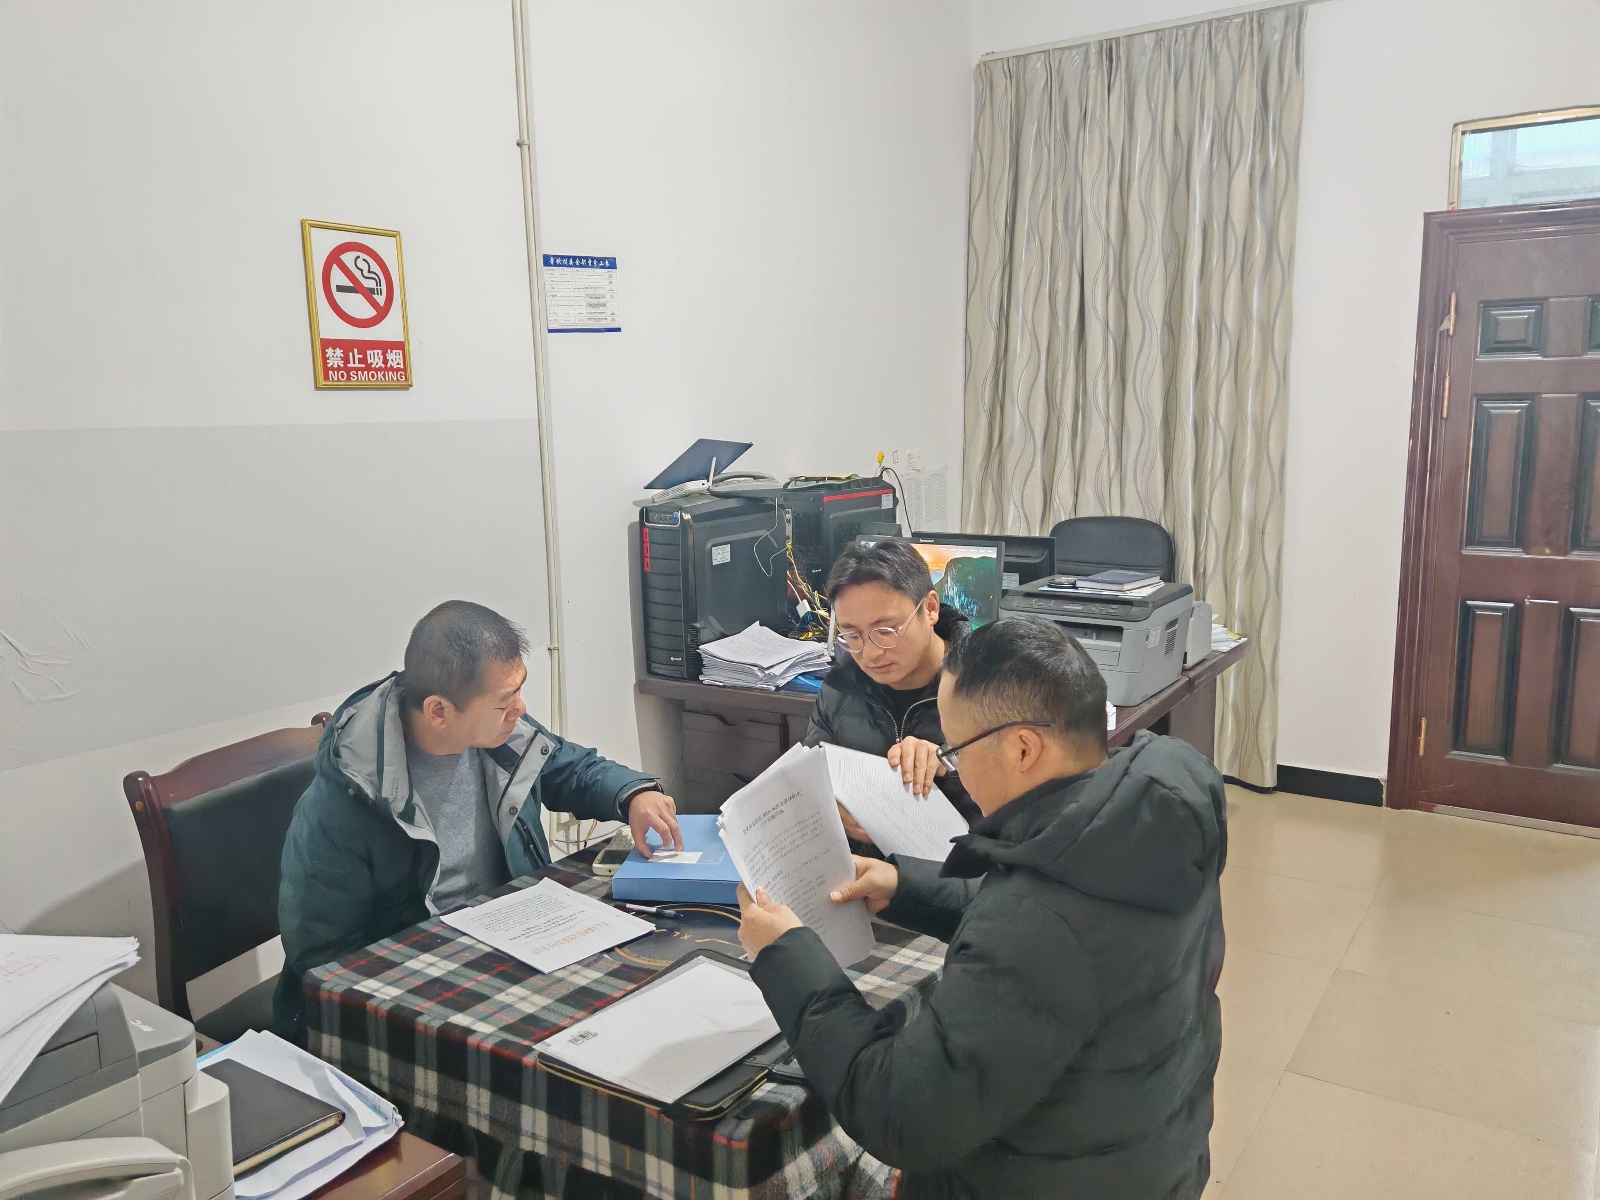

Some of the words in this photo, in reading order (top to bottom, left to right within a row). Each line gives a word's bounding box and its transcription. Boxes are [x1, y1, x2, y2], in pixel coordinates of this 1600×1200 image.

[325, 347, 404, 369] 禁止吸烟
[329, 371, 347, 381] NO
[350, 371, 406, 381] SMOKING
